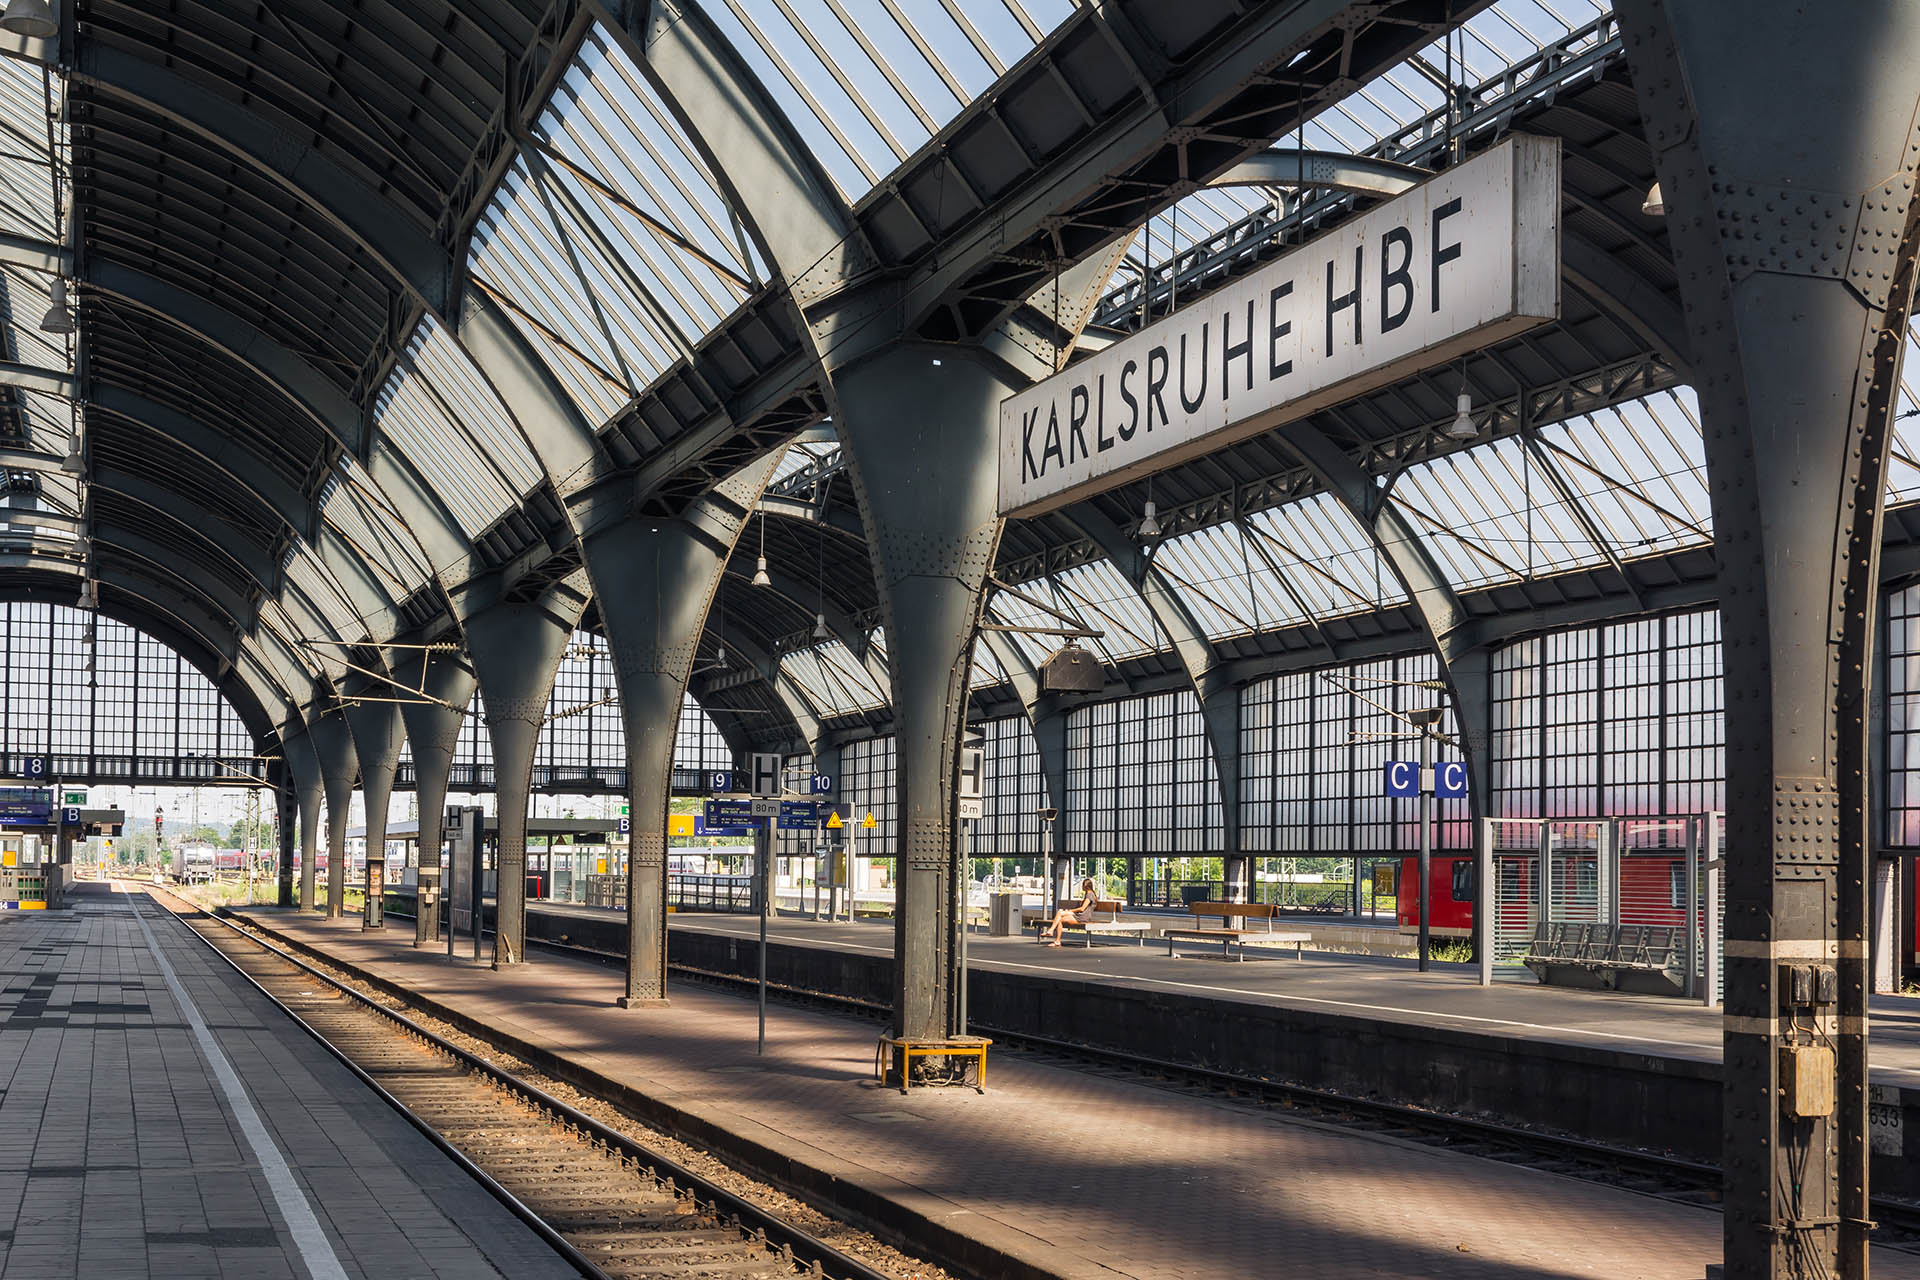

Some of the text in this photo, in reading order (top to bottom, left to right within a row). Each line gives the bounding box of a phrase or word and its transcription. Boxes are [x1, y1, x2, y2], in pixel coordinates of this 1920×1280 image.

[1021, 196, 1462, 485] KARLSRUHE HBF
[31, 758, 42, 773] 8
[715, 773, 725, 787] 9
[755, 756, 778, 793] H
[1391, 762, 1409, 789] C
[1444, 763, 1462, 790] C
[814, 775, 830, 789] 10
[44, 793, 49, 801] 8
[68, 808, 79, 821] B
[755, 804, 767, 812] 80
[448, 807, 461, 827] H
[620, 818, 630, 831] B
[79, 832, 86, 841] A
